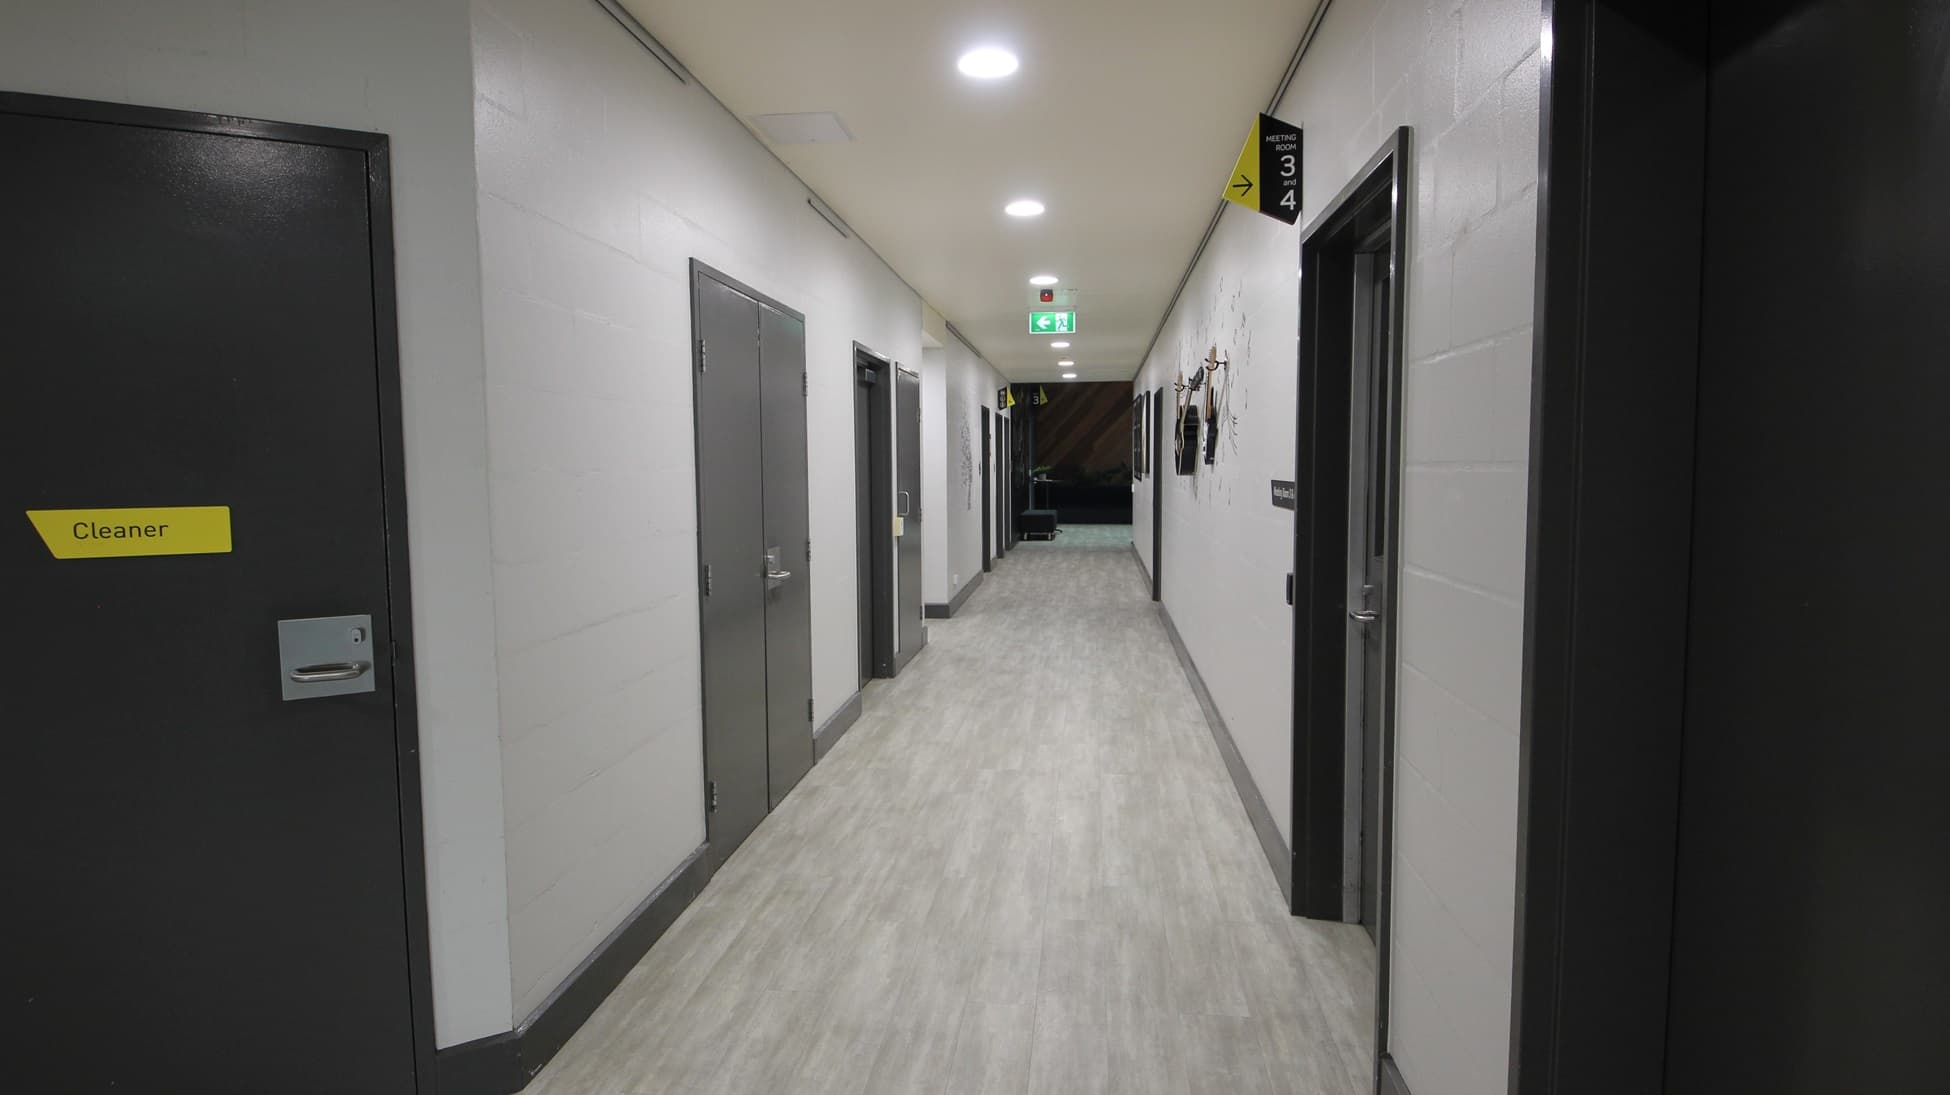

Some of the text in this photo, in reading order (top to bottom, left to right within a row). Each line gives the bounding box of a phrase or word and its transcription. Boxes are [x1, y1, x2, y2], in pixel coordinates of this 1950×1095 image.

[1266, 134, 1297, 142] MEETING
[1280, 155, 1296, 177] 3
[1280, 189, 1296, 210] 4
[72, 521, 169, 540] Cleaner
